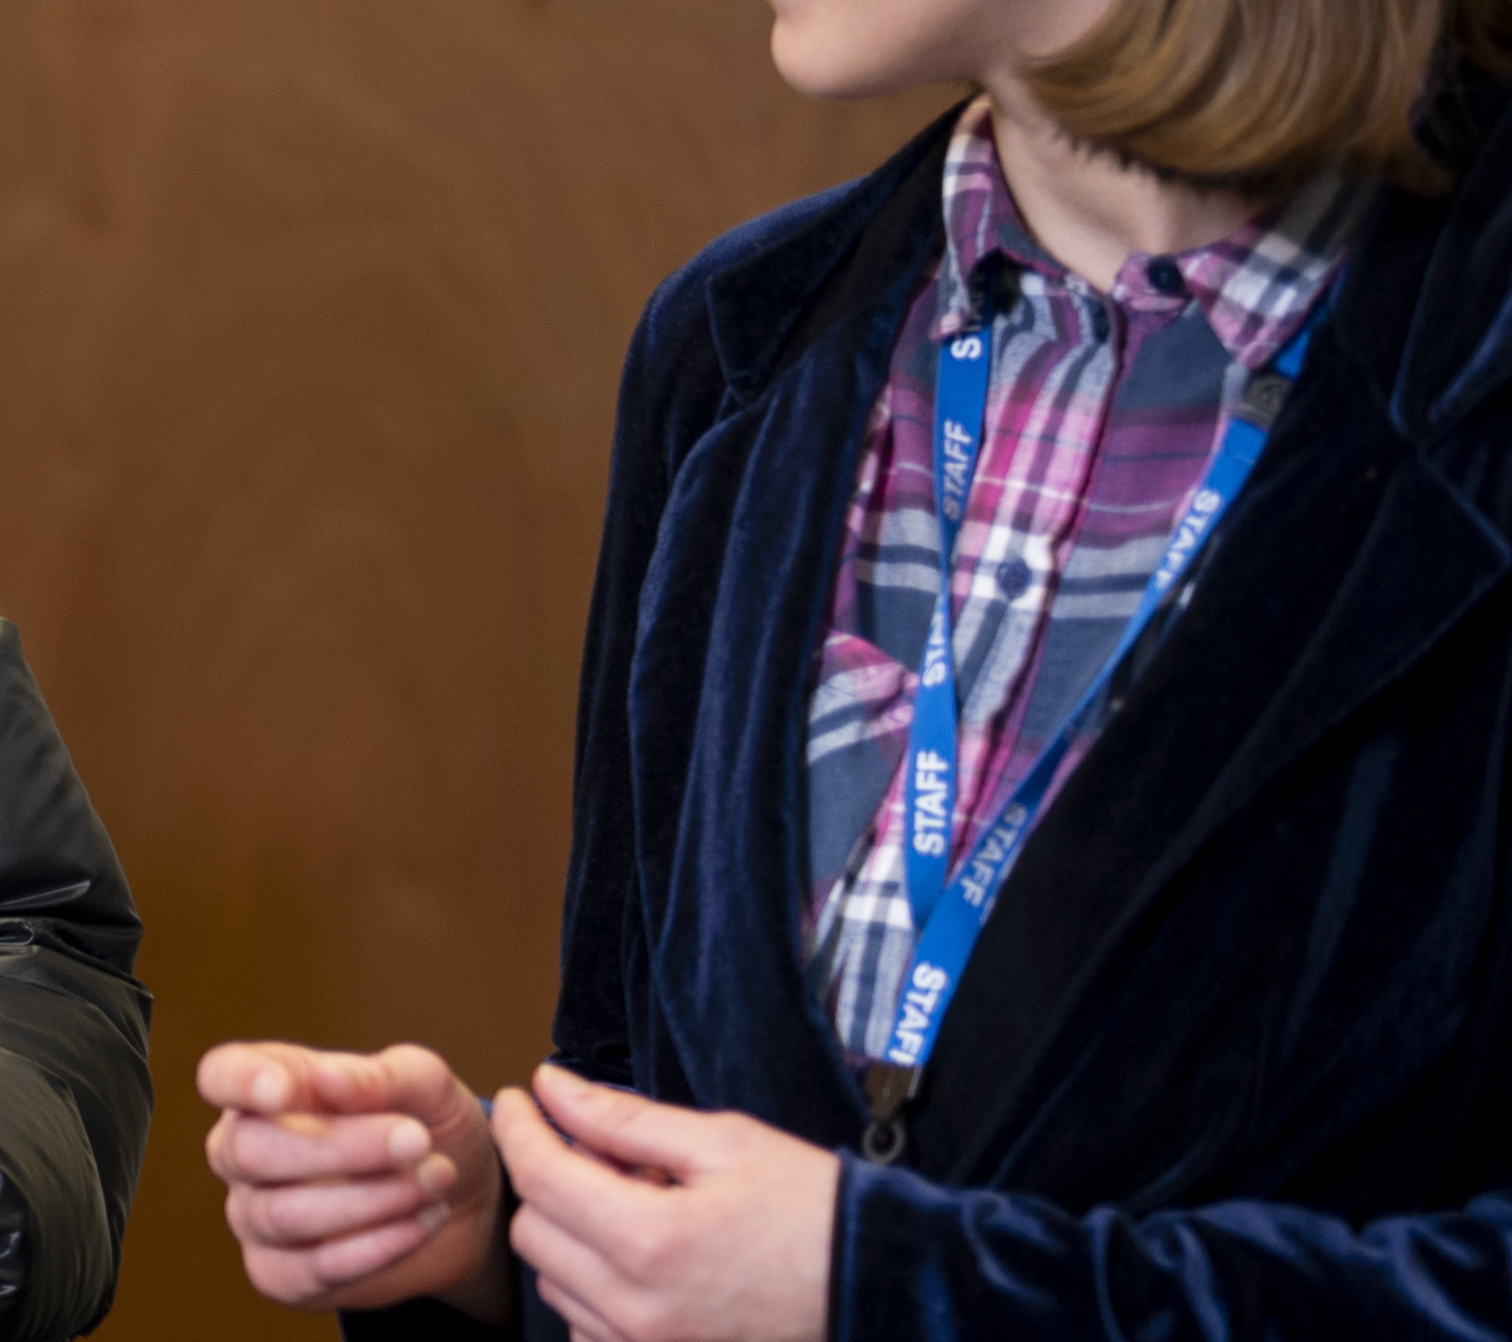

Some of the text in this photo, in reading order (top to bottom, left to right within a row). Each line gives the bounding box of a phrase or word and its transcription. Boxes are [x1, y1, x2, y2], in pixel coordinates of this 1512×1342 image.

[942, 421, 975, 521] STAFF
[1153, 489, 1221, 591] STAFF
[912, 750, 949, 857] STAFF
[959, 802, 1028, 908] STAFF
